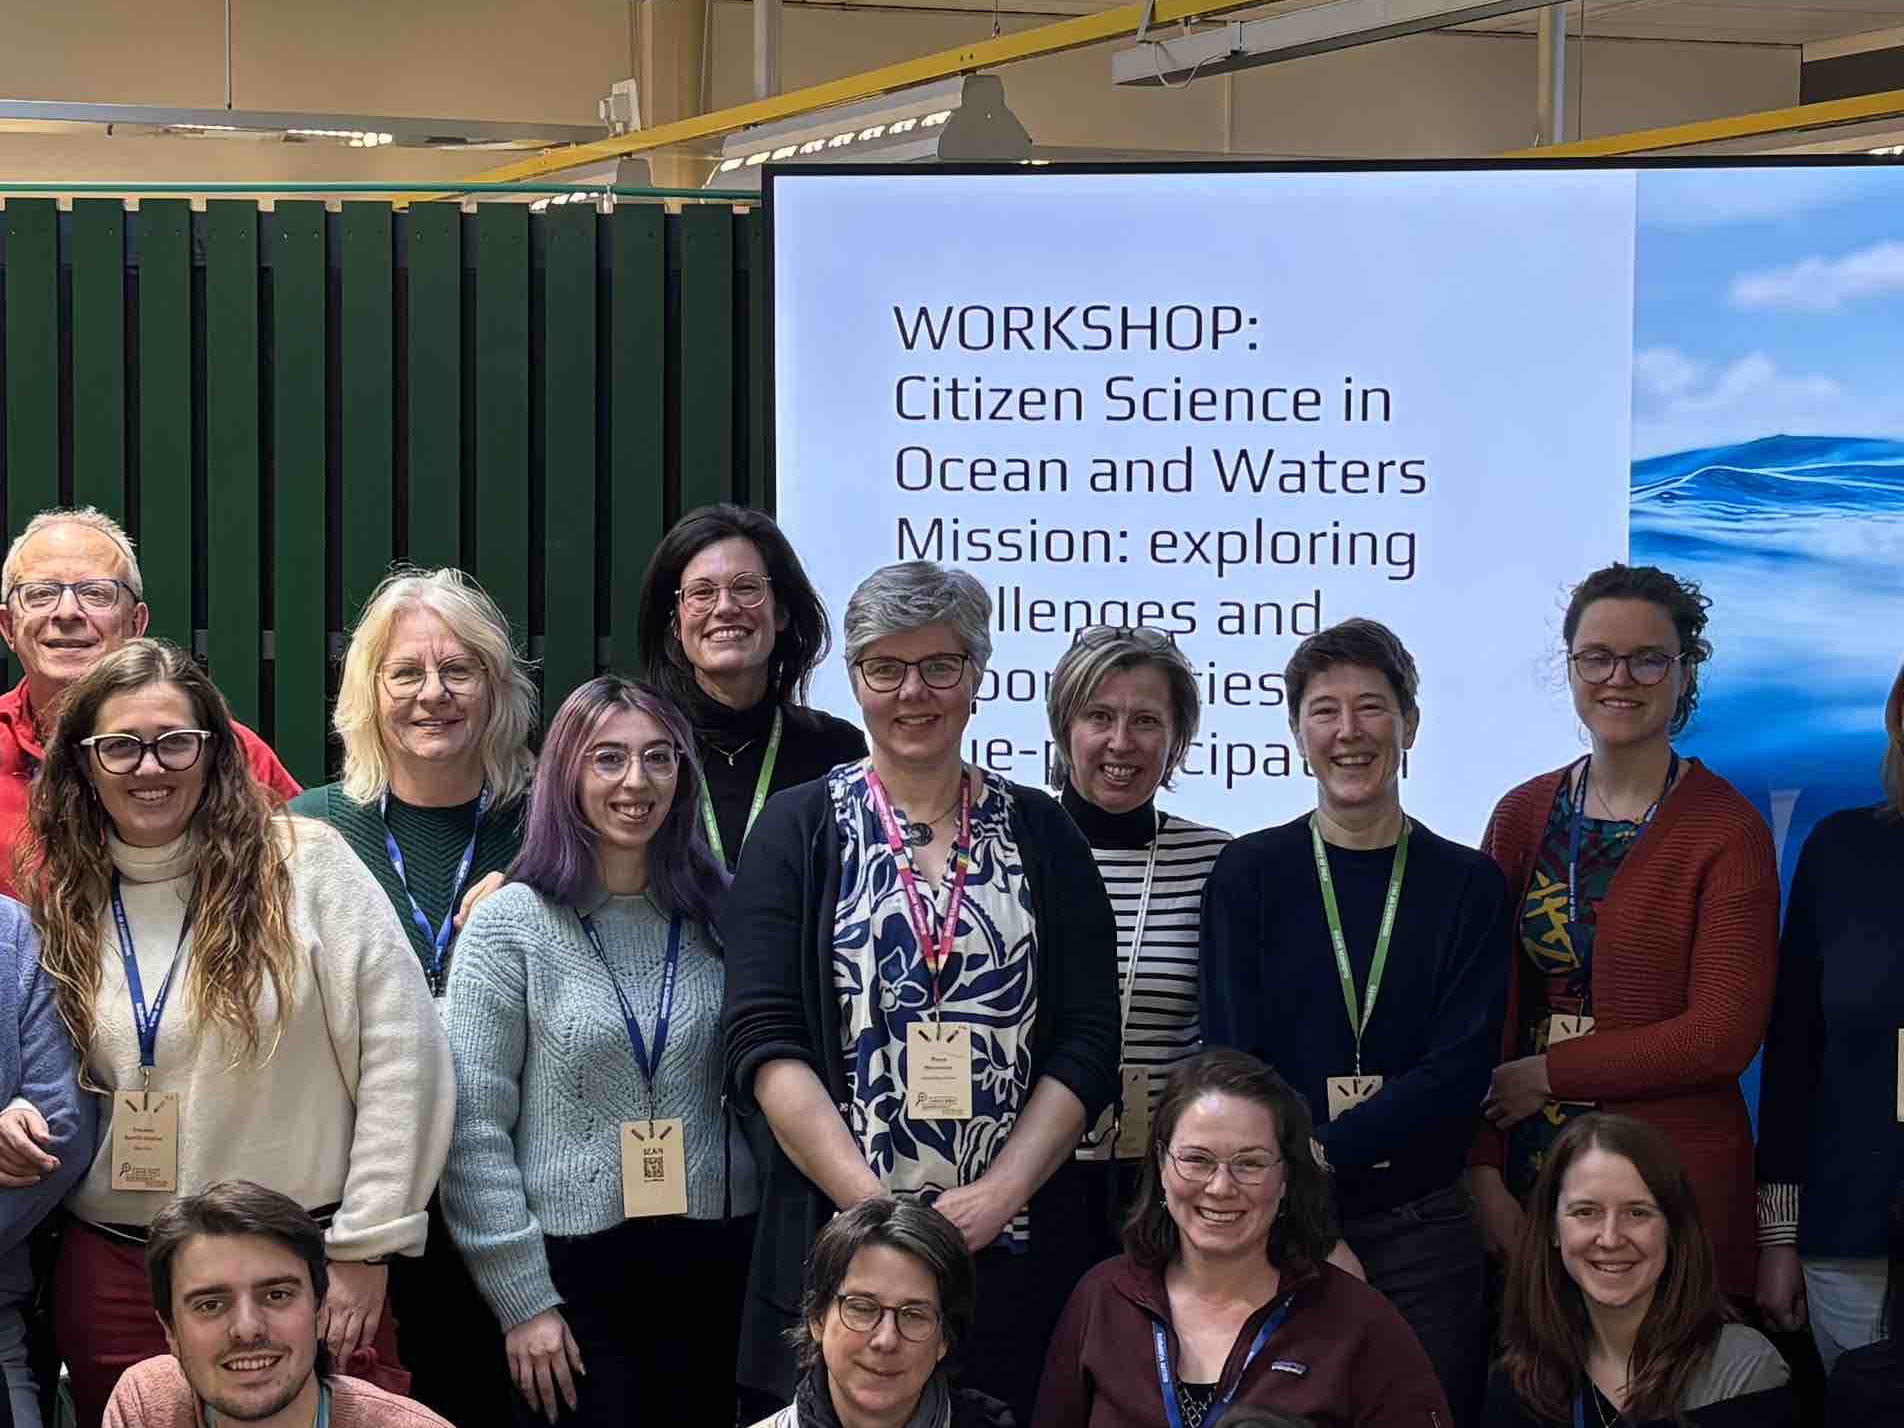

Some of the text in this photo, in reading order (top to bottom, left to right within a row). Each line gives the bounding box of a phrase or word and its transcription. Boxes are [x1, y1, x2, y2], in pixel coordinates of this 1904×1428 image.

[893, 305, 1258, 351] WORKSHOP:
[896, 376, 1390, 422] Citizen Science in
[896, 445, 1426, 494] Ocean and Waters
[898, 517, 1416, 581] Mission: exploring
[998, 586, 1321, 638] llenges and
[643, 1148, 665, 1157] SCAN
